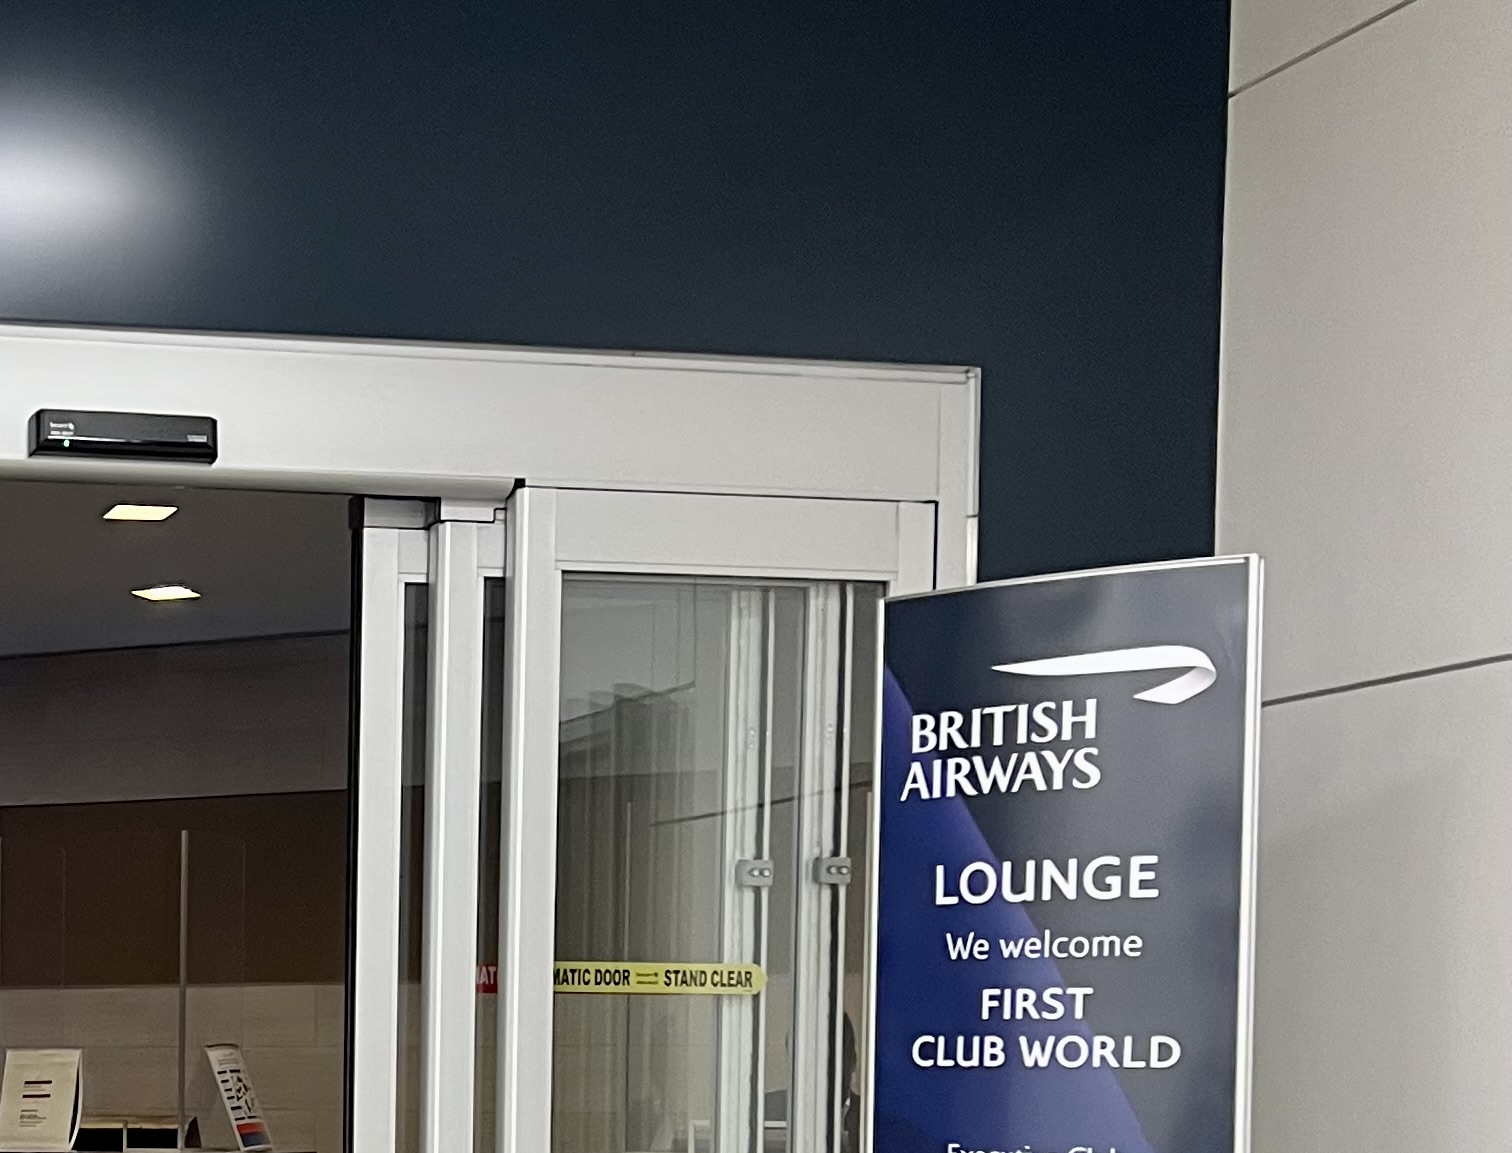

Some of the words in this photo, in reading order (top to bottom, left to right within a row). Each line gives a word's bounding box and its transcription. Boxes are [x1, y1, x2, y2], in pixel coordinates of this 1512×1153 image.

[911, 698, 1097, 753] BRITISH
[900, 747, 1101, 801] AIRWAYS
[935, 854, 1160, 905] LOUNGE
[945, 932, 990, 960] We
[999, 929, 1143, 959] welcome
[594, 968, 630, 986] DOOR
[663, 969, 707, 987] STAND
[710, 970, 753, 988] CLEAR
[981, 986, 1094, 1020] FIRST
[911, 1035, 1006, 1068] CLUB
[1018, 1034, 1182, 1069] WORLD
